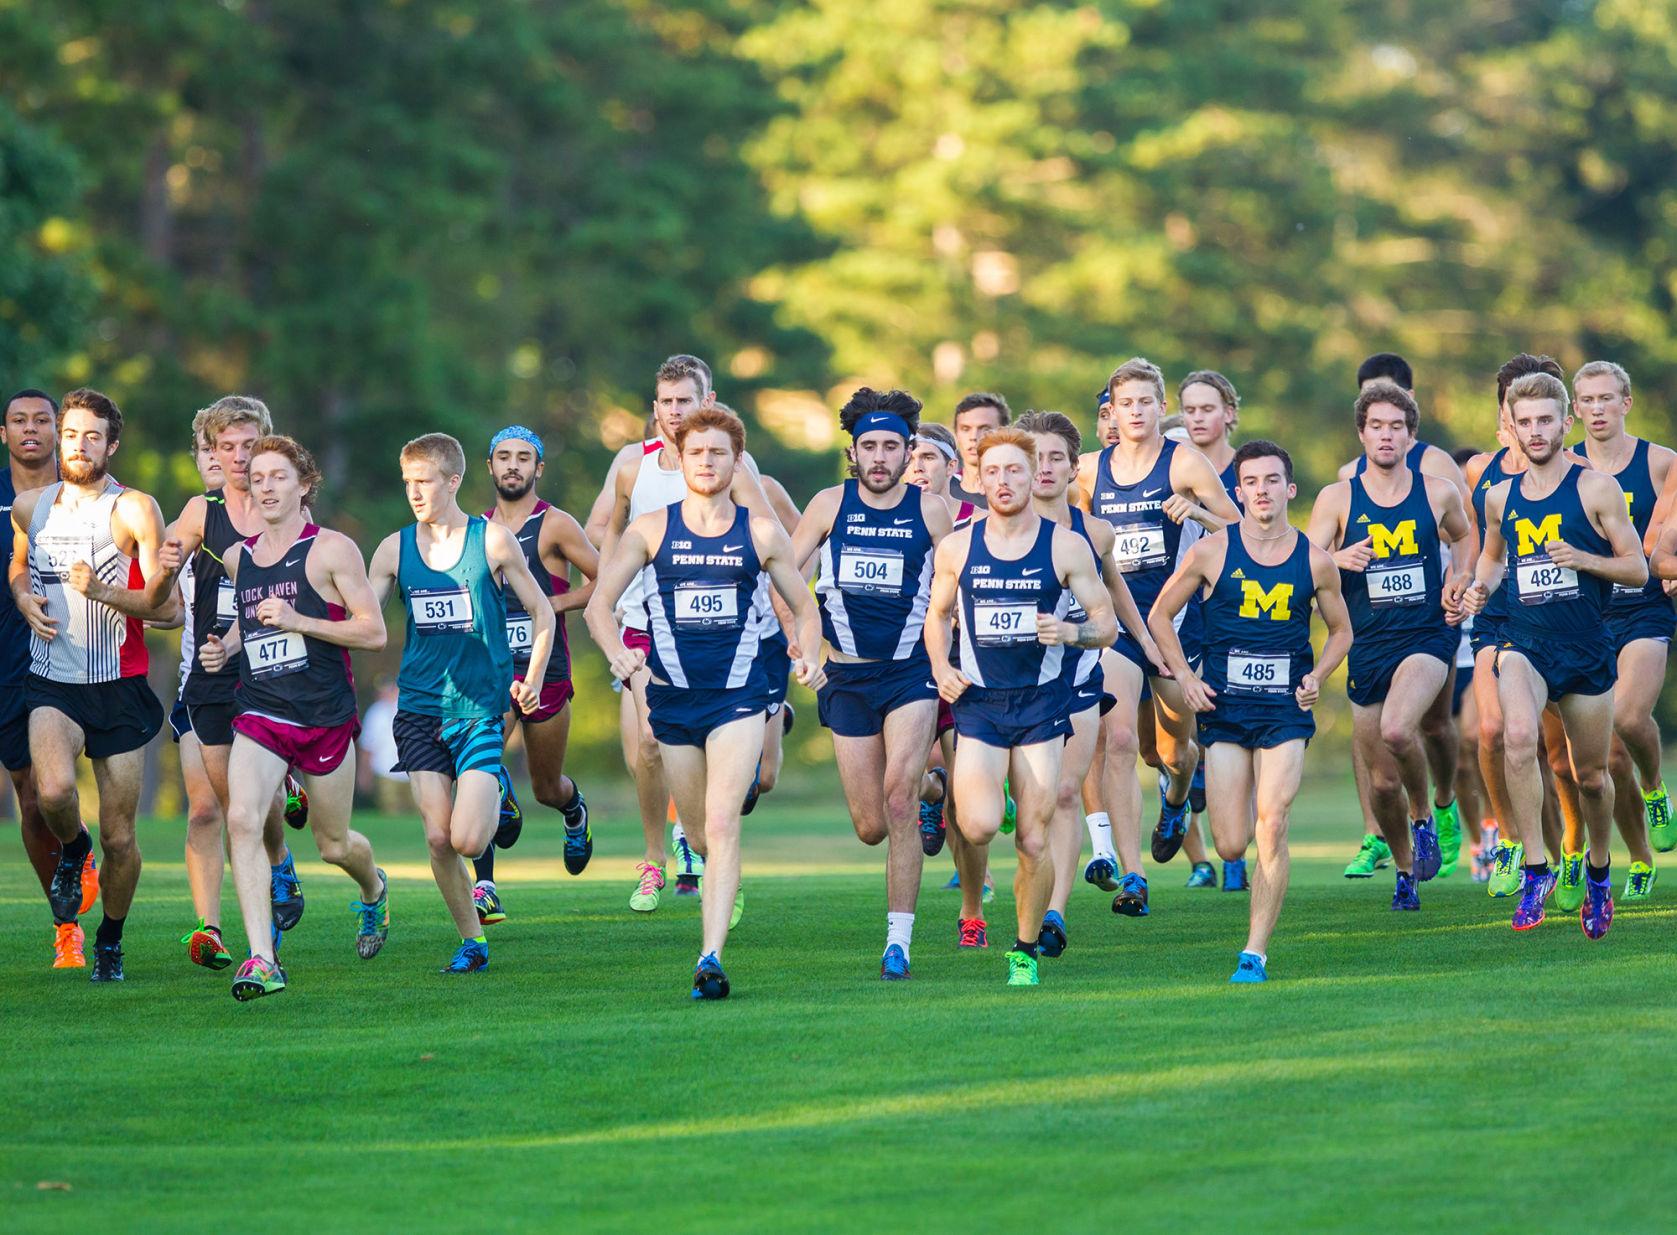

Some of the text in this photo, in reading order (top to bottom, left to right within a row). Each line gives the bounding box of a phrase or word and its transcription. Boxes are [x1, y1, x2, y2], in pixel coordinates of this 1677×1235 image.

[1101, 500, 1162, 514] PENN STATE
[846, 526, 913, 539] PENN STATE
[1367, 519, 1419, 558] M
[1515, 513, 1564, 557] M
[1120, 536, 1151, 555] 492
[48, 550, 77, 568] 52
[672, 554, 743, 567] PENN STATE
[854, 560, 888, 580] 504
[1530, 566, 1564, 587] 482
[972, 578, 1041, 590] PENN STATE
[1381, 573, 1413, 592] 488
[240, 586, 264, 604] LOCK
[268, 581, 299, 599] HAVEN
[1239, 579, 1294, 621] M
[425, 599, 455, 619] 531
[690, 594, 723, 613] 495
[989, 611, 1023, 630] 497
[506, 624, 528, 643] 76
[259, 638, 289, 662] 477
[1241, 662, 1275, 681] 485
